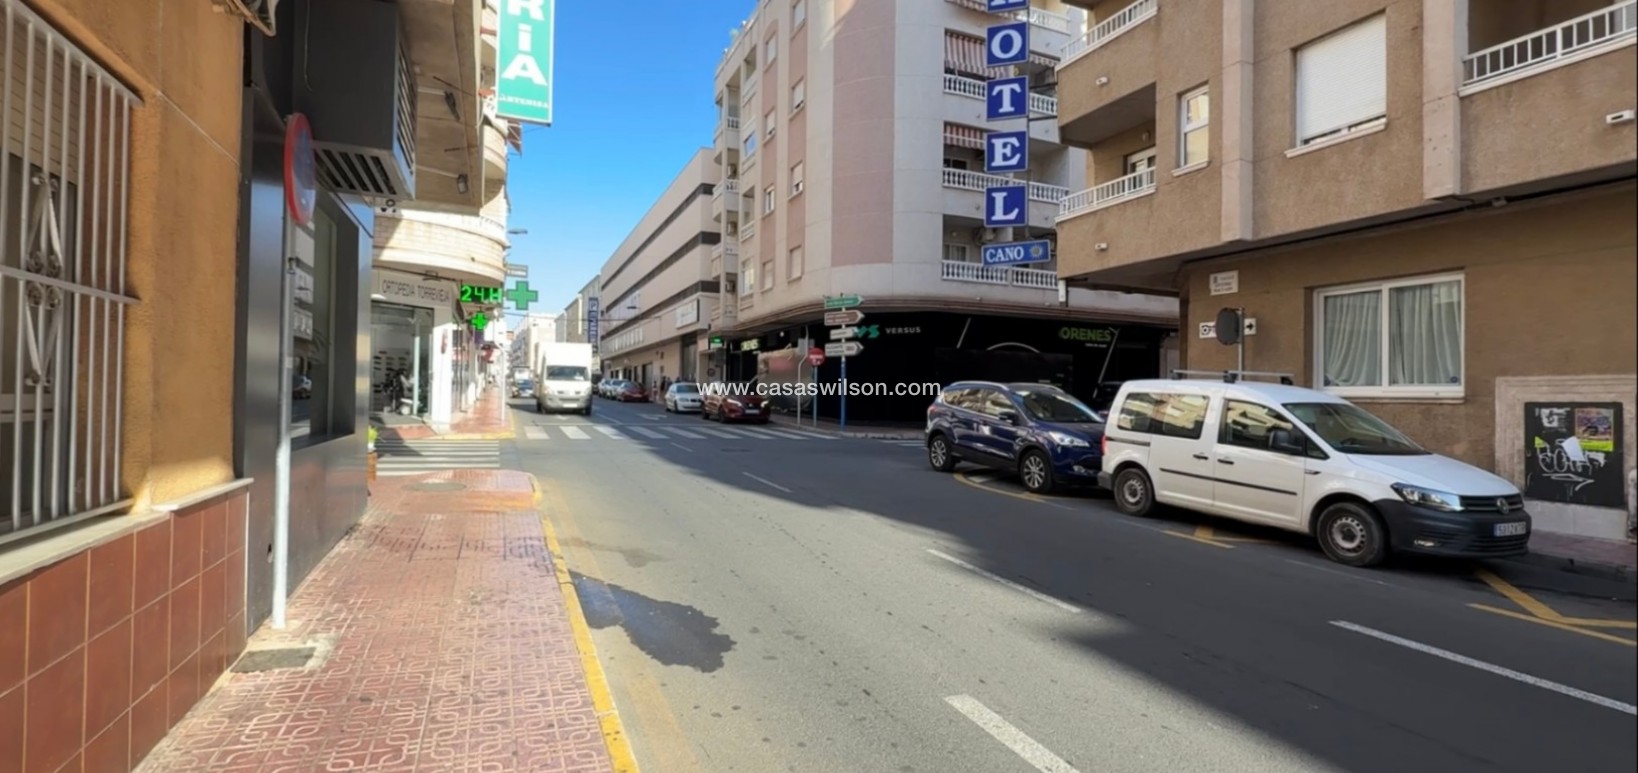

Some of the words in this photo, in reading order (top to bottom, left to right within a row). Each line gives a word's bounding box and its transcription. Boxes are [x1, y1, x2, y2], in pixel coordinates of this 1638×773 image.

[990, 0, 1024, 221] OTEL
[985, 246, 1024, 263] CANO
[885, 326, 921, 335] VERSUS
[1058, 327, 1111, 341] ORENES
